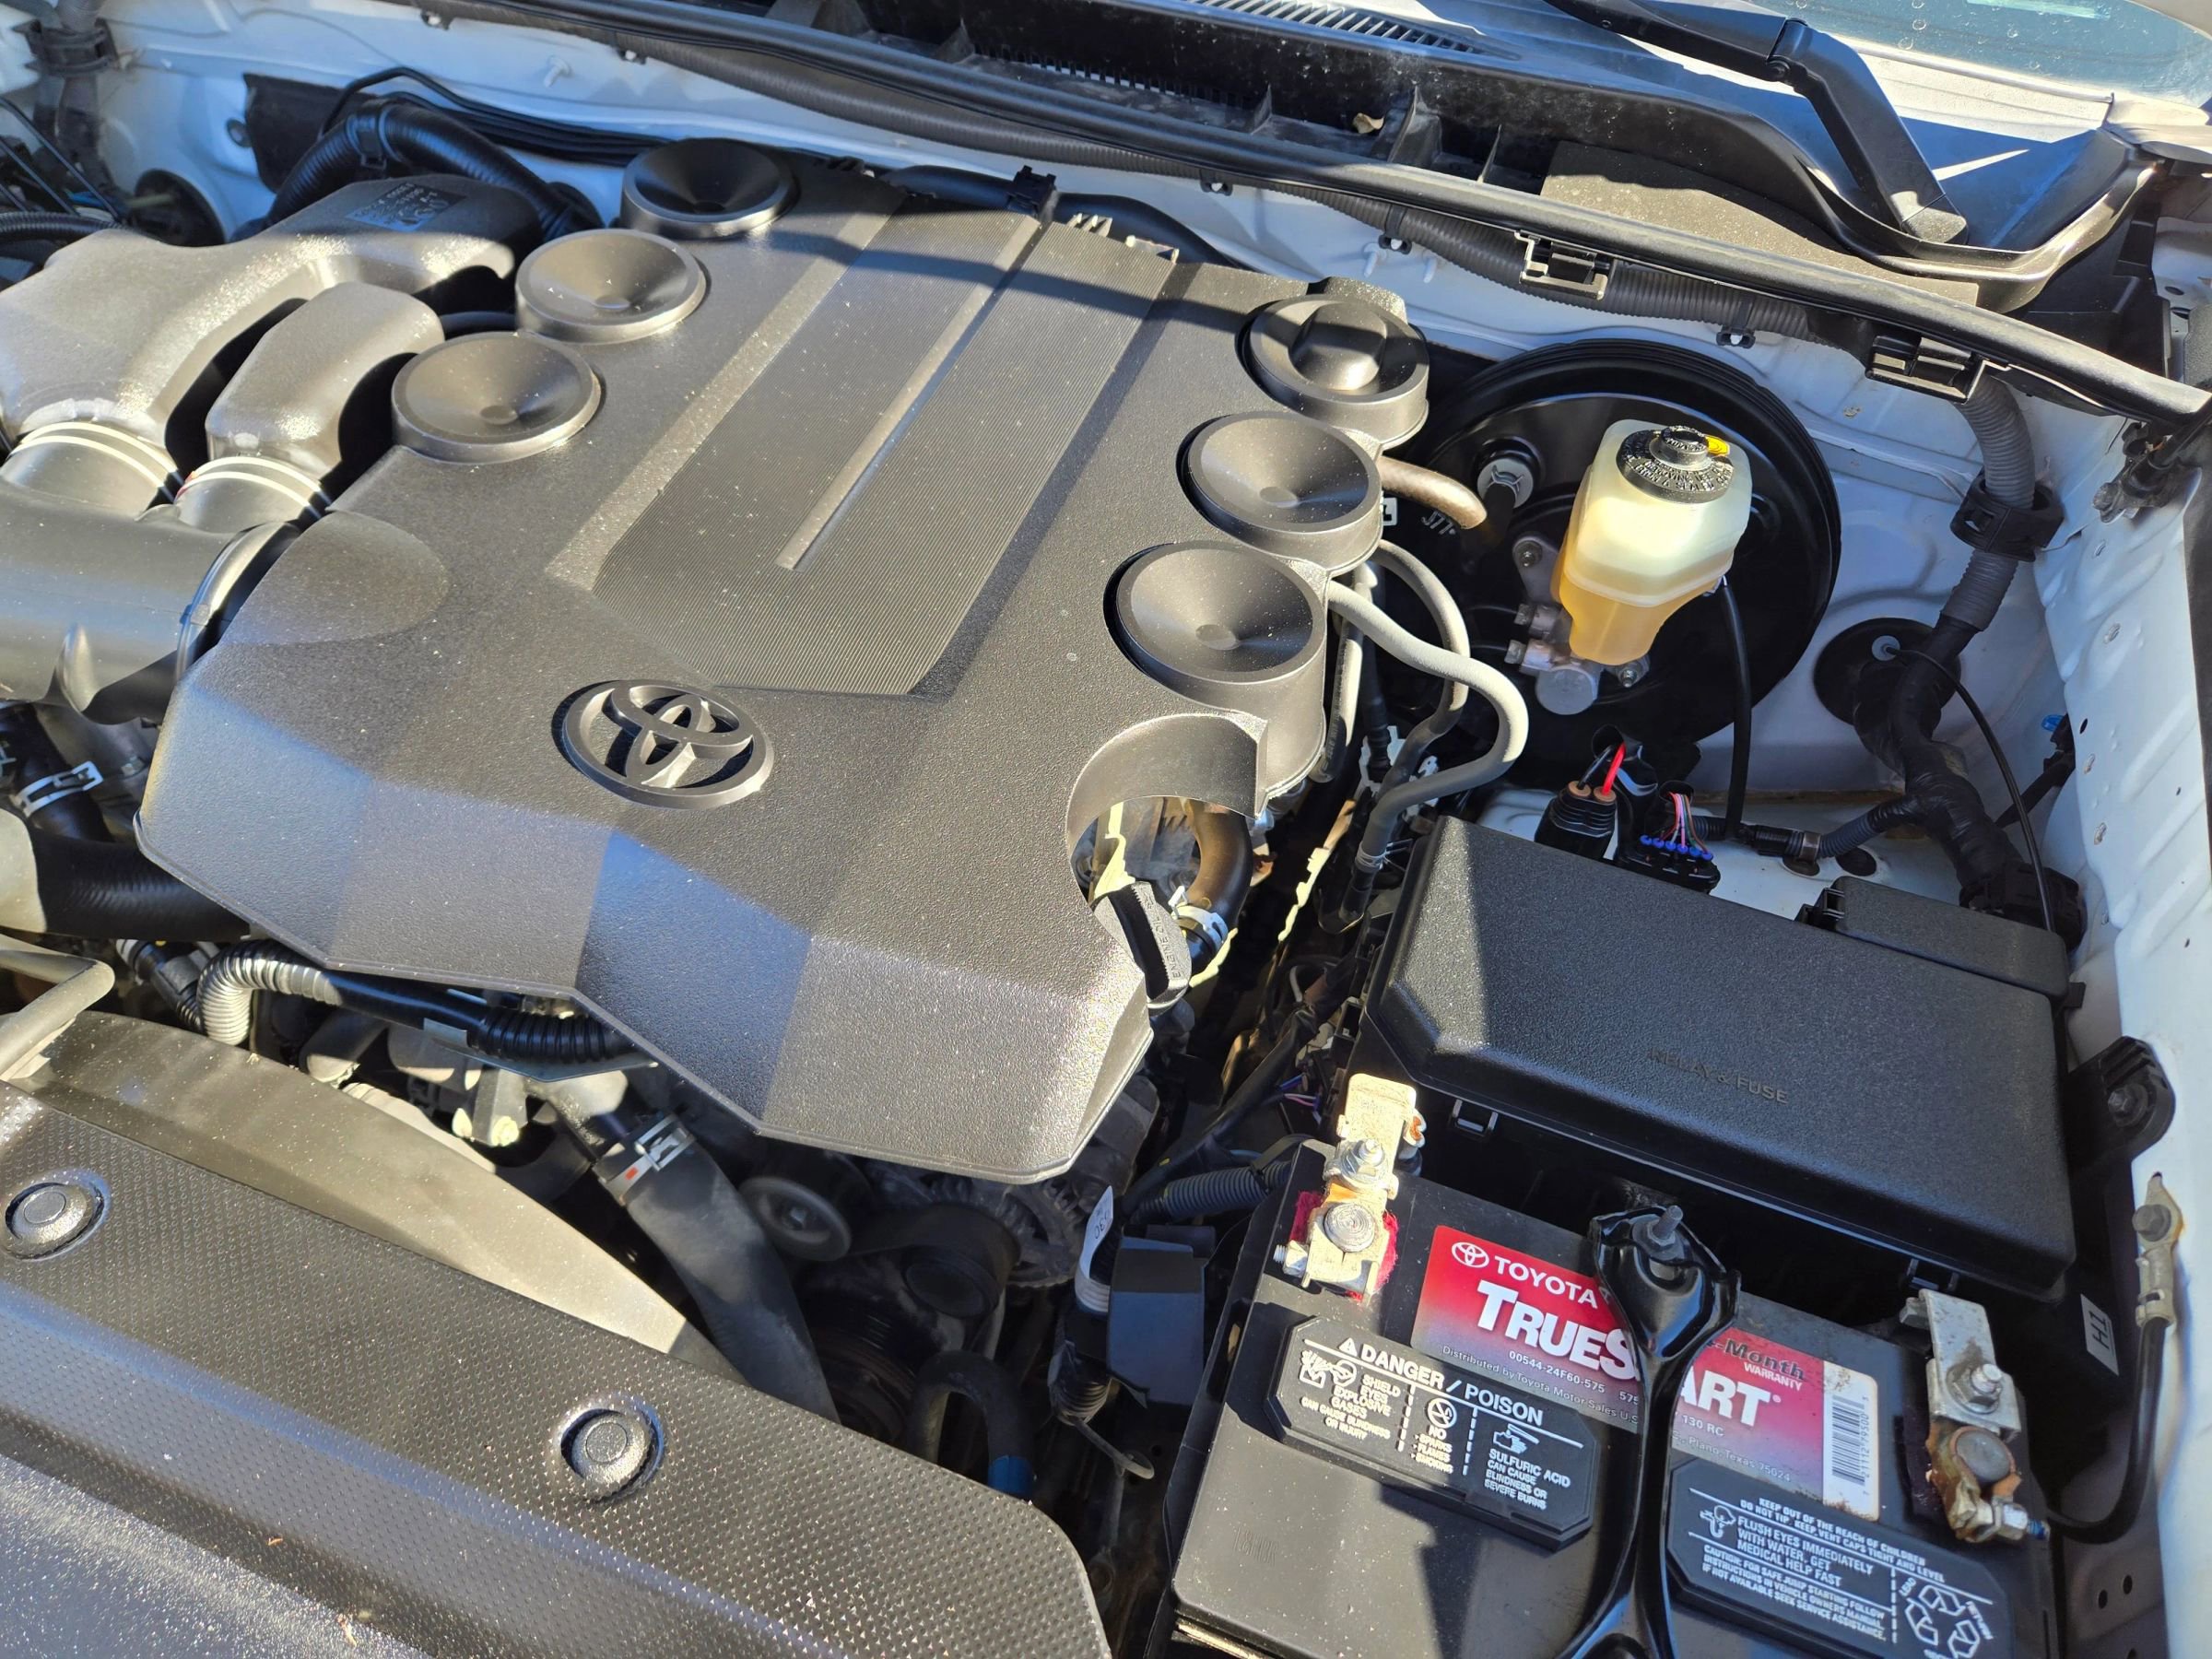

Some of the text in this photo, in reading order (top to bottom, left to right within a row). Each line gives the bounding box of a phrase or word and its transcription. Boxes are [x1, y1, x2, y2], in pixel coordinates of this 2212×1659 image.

[1159, 936, 1181, 979] ENGINE
[1717, 1072, 1732, 1085] &
[1736, 1075, 1789, 1104] FUSE
[1494, 1255, 1599, 1310] TOYOTA
[1360, 1343, 1543, 1427] DANGER / POISON
[1360, 1384, 1389, 1405] EYES
[1362, 1374, 1401, 1397] SHIELD
[1509, 1350, 1606, 1394] 00544-24F60-575
[1683, 1415, 1703, 1430] 130
[1707, 1422, 1724, 1437] RC
[1744, 1361, 1803, 1392] WARRANTY
[1331, 1395, 1368, 1419] GASES
[1333, 1384, 1392, 1418] EXPLOSIVE
[1442, 1346, 1500, 1373] Distributed
[1502, 1367, 1516, 1381] by
[1516, 1371, 1550, 1393] Toyota
[1553, 1385, 1585, 1406] Motor
[1588, 1398, 1617, 1418] Sales
[1724, 1449, 1755, 1469] Texas
[1759, 1459, 1792, 1483] 75024
[1429, 1425, 1447, 1441] NO
[1486, 1468, 1548, 1500] BLINDNESS OR
[1487, 1459, 1537, 1486] CAN CAUSE
[1488, 1448, 1571, 1488] SULFURIC ACID
[1484, 1478, 1547, 1511] SEVERE BURNS
[1737, 1515, 1874, 1576] FLUSH EYES IMMEDIATELY
[1737, 1528, 1766, 1547] WITH
[1810, 1555, 1831, 1571] GET
[1740, 1499, 1753, 1511] DO
[1755, 1504, 1774, 1520] NOT
[1843, 1536, 1866, 1553] CAPS
[1868, 1547, 1895, 1563] TIGHT
[1896, 1558, 1916, 1572] AND
[1917, 1565, 1945, 1583] LEVEL
[1759, 1497, 1926, 1567] KEEP OUT OF THE REACH OF CHILDREN
[1737, 1539, 1842, 1587] MEDICAL HELP FAST
[1743, 1559, 1761, 1574] FOR
[1761, 1567, 1783, 1582] SAFE
[1712, 1567, 1730, 1580] NOT
[1774, 1591, 1796, 1606] SEEK
[1796, 1599, 1831, 1619] SERVICE
[1763, 1576, 1774, 1588] IN
[1774, 1581, 1808, 1602] VEHICLE
